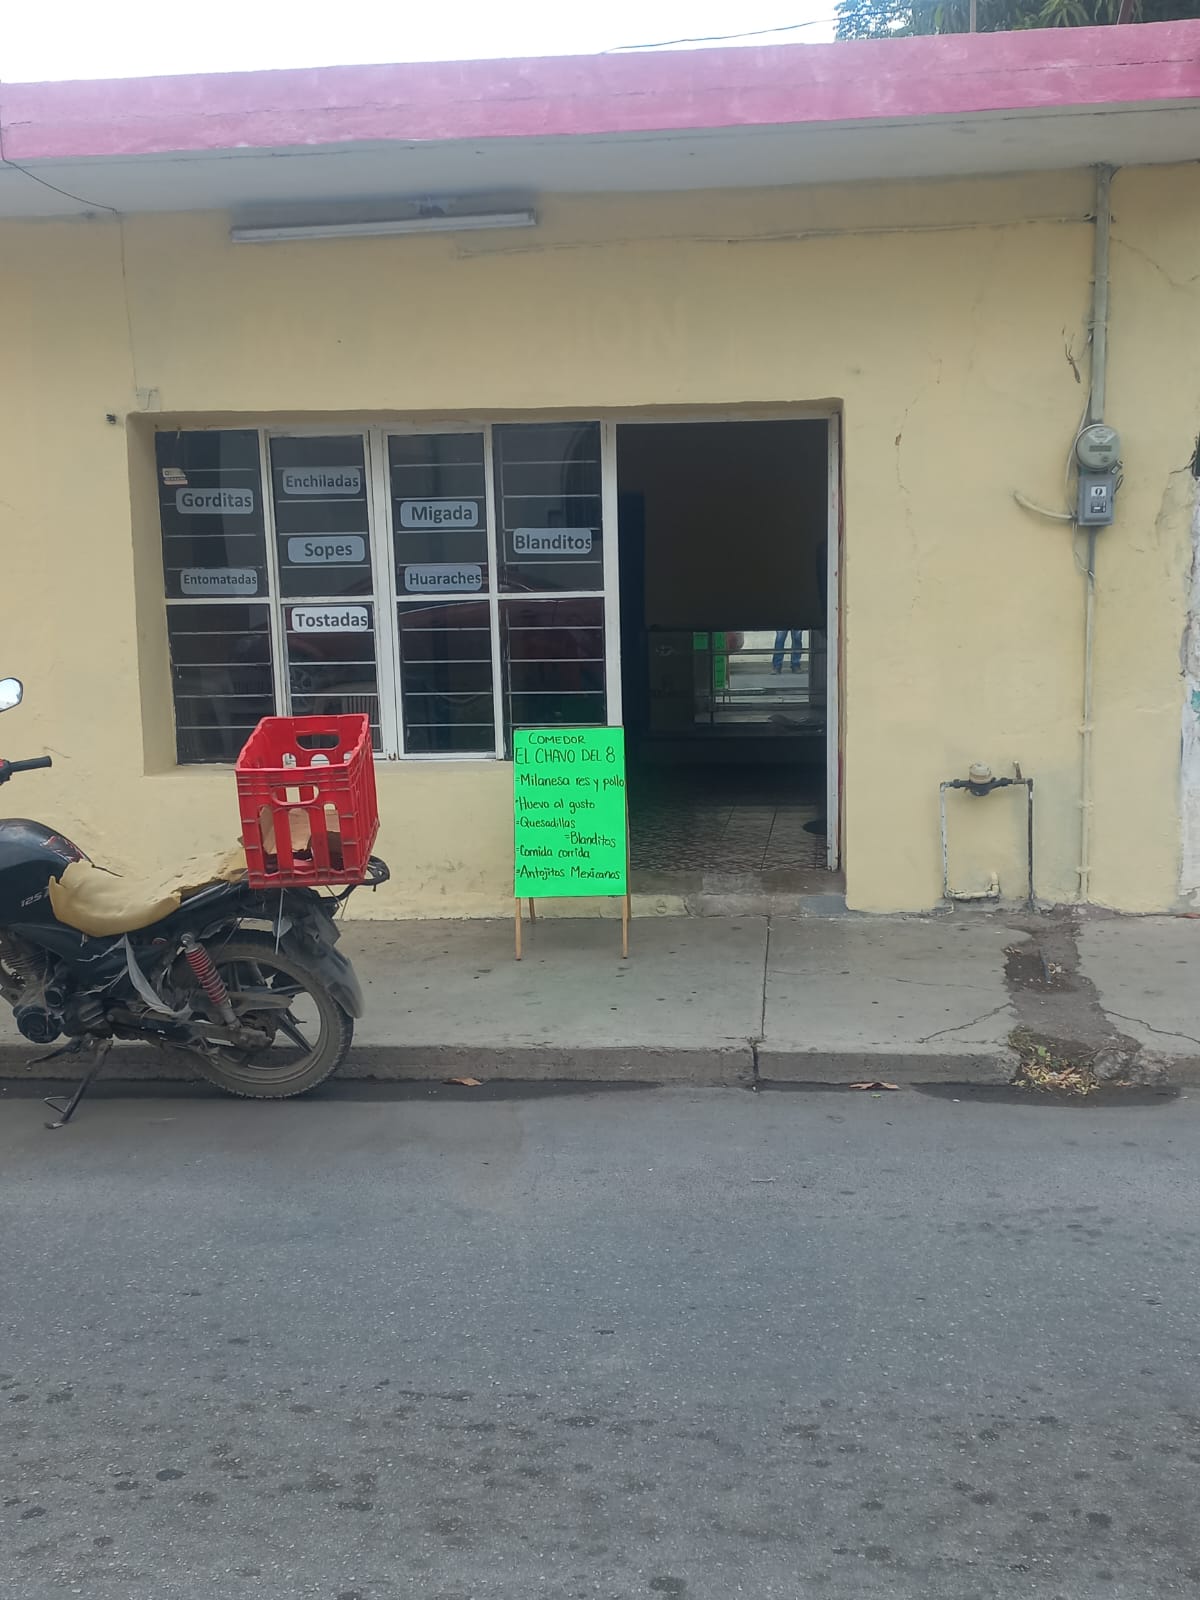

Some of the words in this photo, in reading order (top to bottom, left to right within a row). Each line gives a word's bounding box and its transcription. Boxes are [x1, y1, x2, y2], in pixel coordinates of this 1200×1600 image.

[286, 474, 359, 488] Enchiladas
[181, 493, 252, 508] Gorditas
[411, 505, 473, 523] Migada
[515, 534, 591, 550] Blanditos
[304, 542, 353, 559] Sopes
[183, 574, 257, 585] Entomatadas
[409, 572, 481, 585] Huaraches
[295, 612, 368, 627] Tostadas
[528, 732, 586, 745] COMEDOR
[515, 747, 531, 764] EL
[535, 746, 576, 764] CHAVO
[581, 749, 602, 762] DEL
[605, 746, 616, 763] 8
[575, 776, 591, 787] res
[593, 778, 599, 792] y
[603, 774, 625, 791] pollo
[553, 798, 564, 809] al
[568, 798, 596, 815] gusto
[558, 847, 591, 859] corrida
[570, 865, 621, 880] Mexicanos
